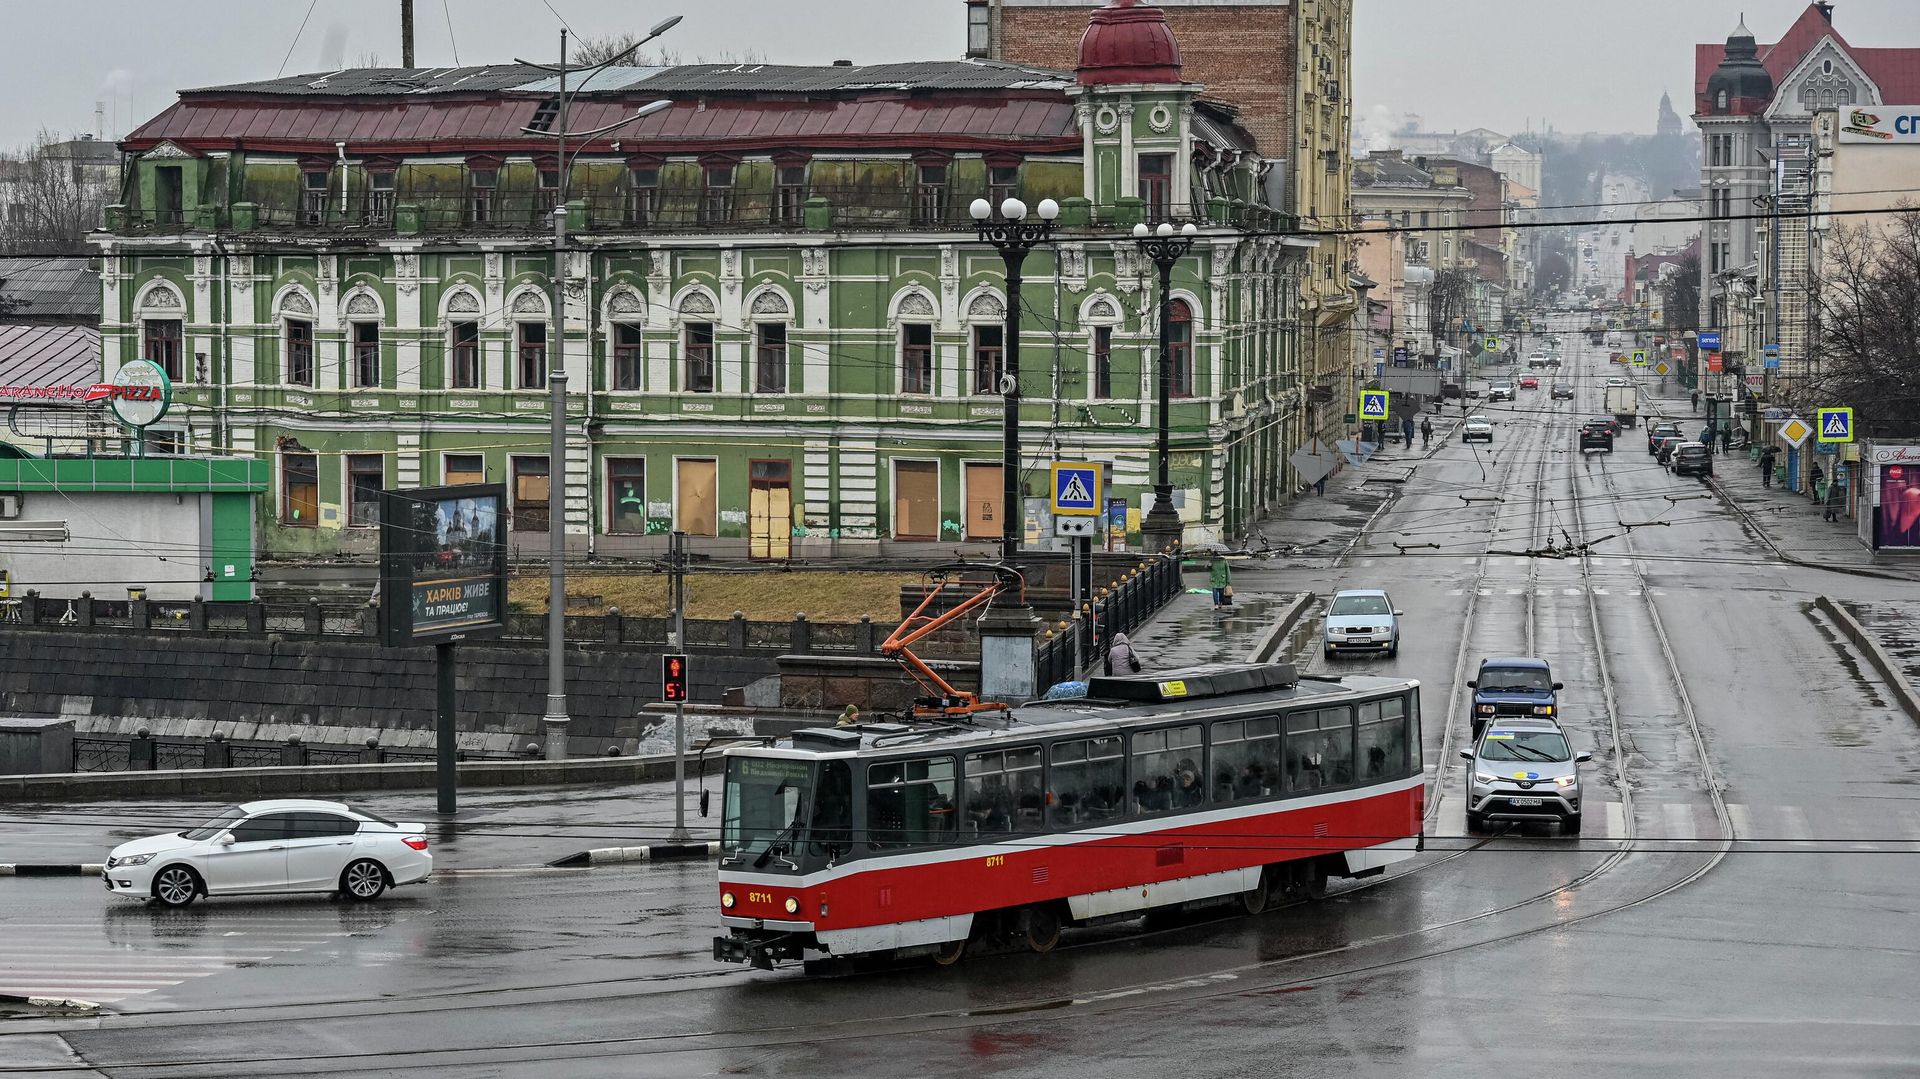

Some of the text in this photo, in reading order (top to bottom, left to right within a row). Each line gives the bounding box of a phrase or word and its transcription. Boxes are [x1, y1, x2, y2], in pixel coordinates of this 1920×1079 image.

[1746, 376, 1763, 385] ФОТО
[111, 385, 163, 400] PIZZA
[426, 583, 489, 603] ХАРКІВ ЖИВЕ
[425, 602, 468, 617] ТА ПРАЦЮЄ!
[742, 760, 749, 774] 6
[986, 856, 1004, 867] 8711
[749, 892, 772, 903] 8711
